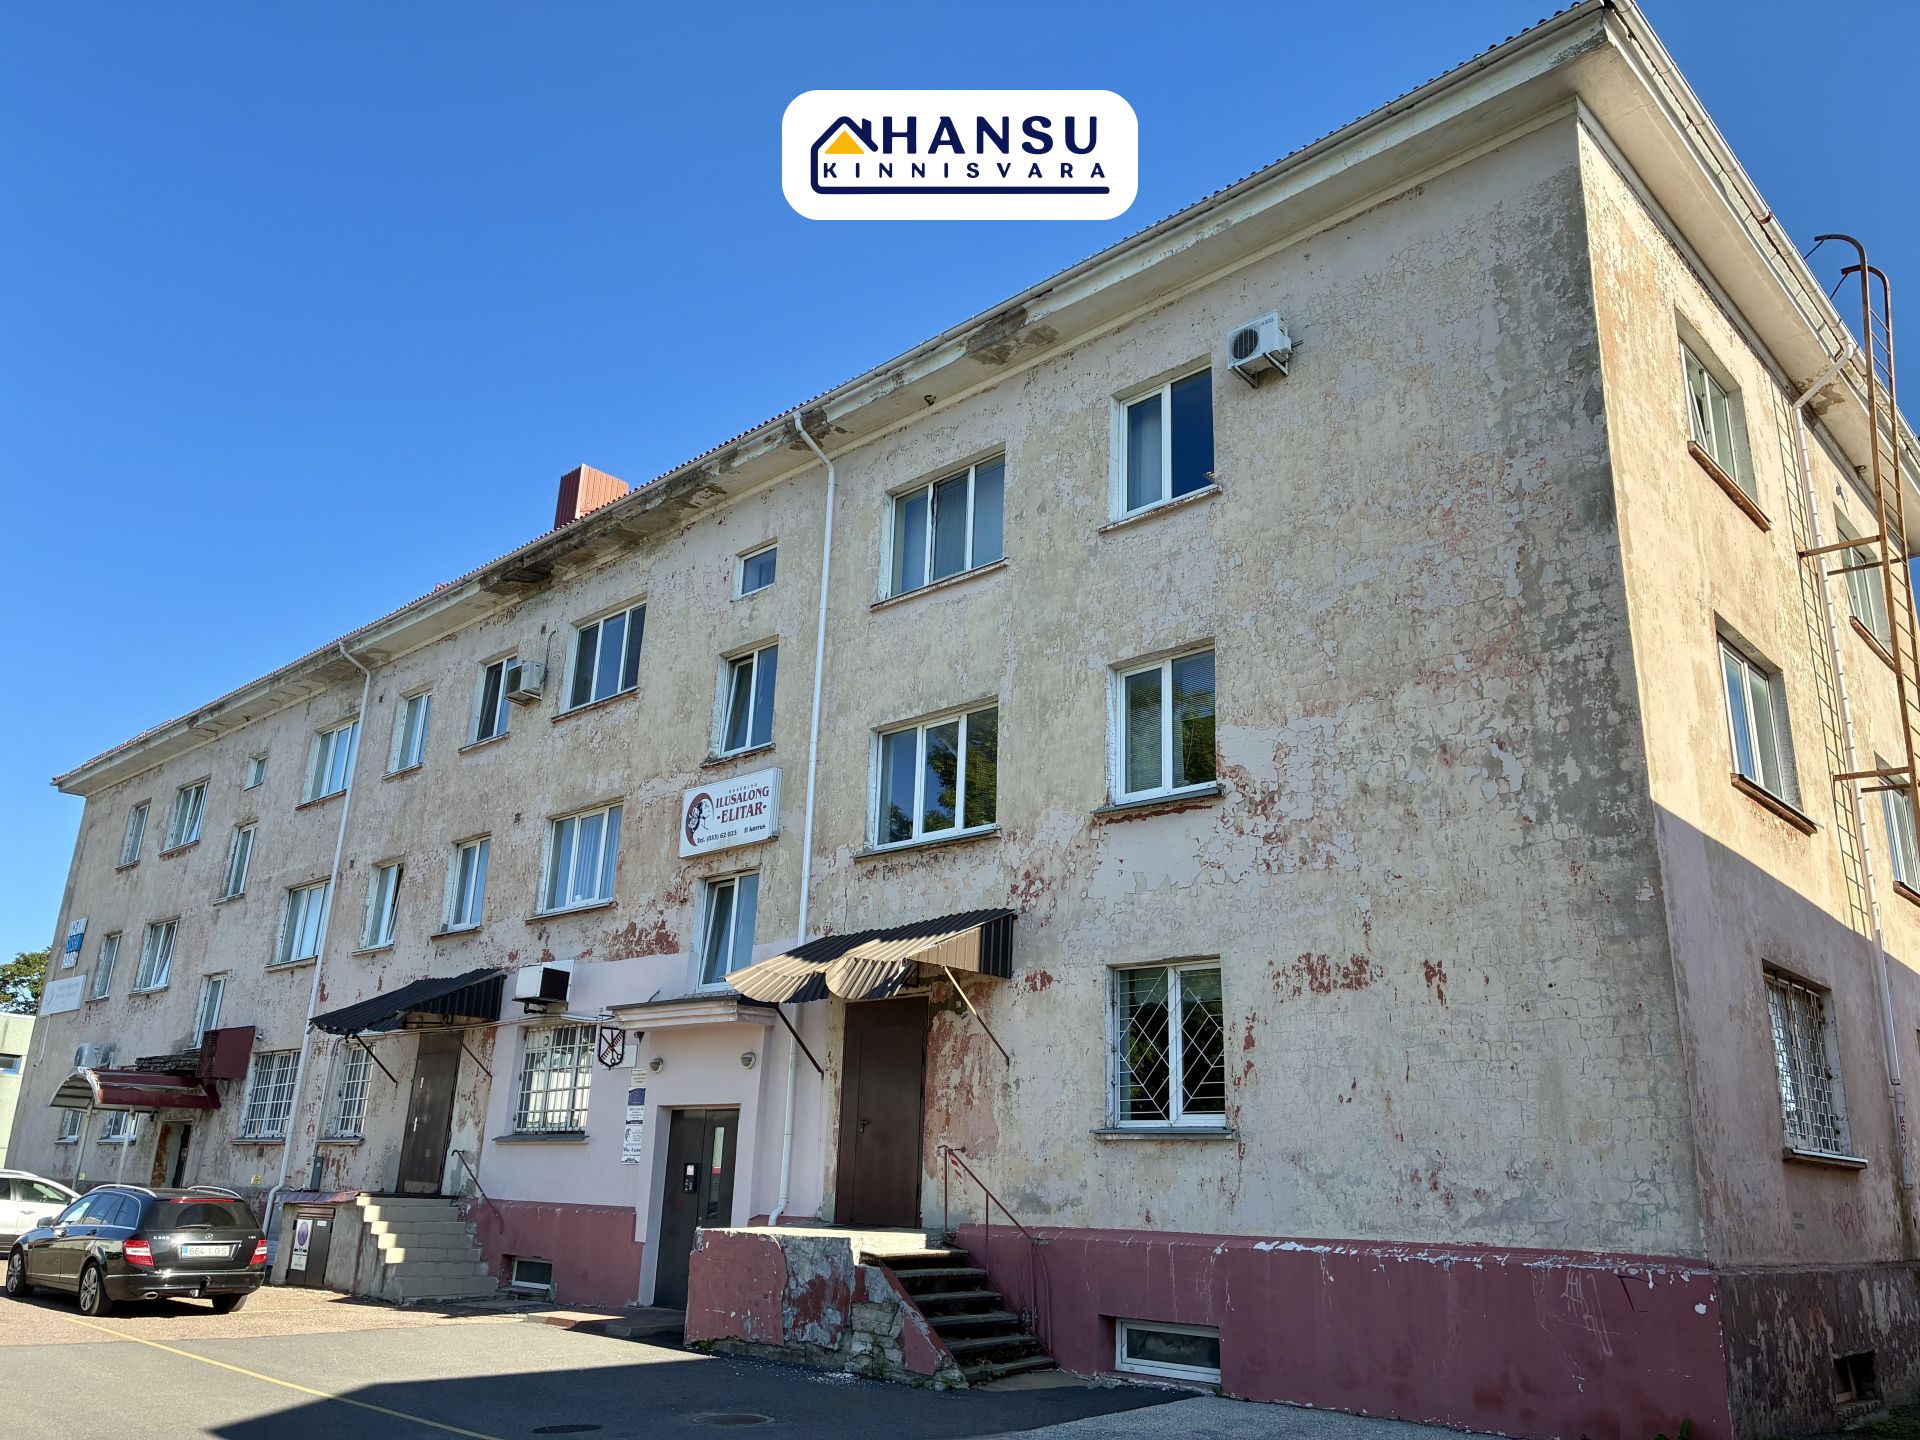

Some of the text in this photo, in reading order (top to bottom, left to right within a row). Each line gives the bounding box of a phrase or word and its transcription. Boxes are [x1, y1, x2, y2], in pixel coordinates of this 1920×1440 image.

[716, 786, 770, 808] ILUSALONG
[749, 824, 766, 832] korrus
[189, 1247, 227, 1256] 664 LGS
